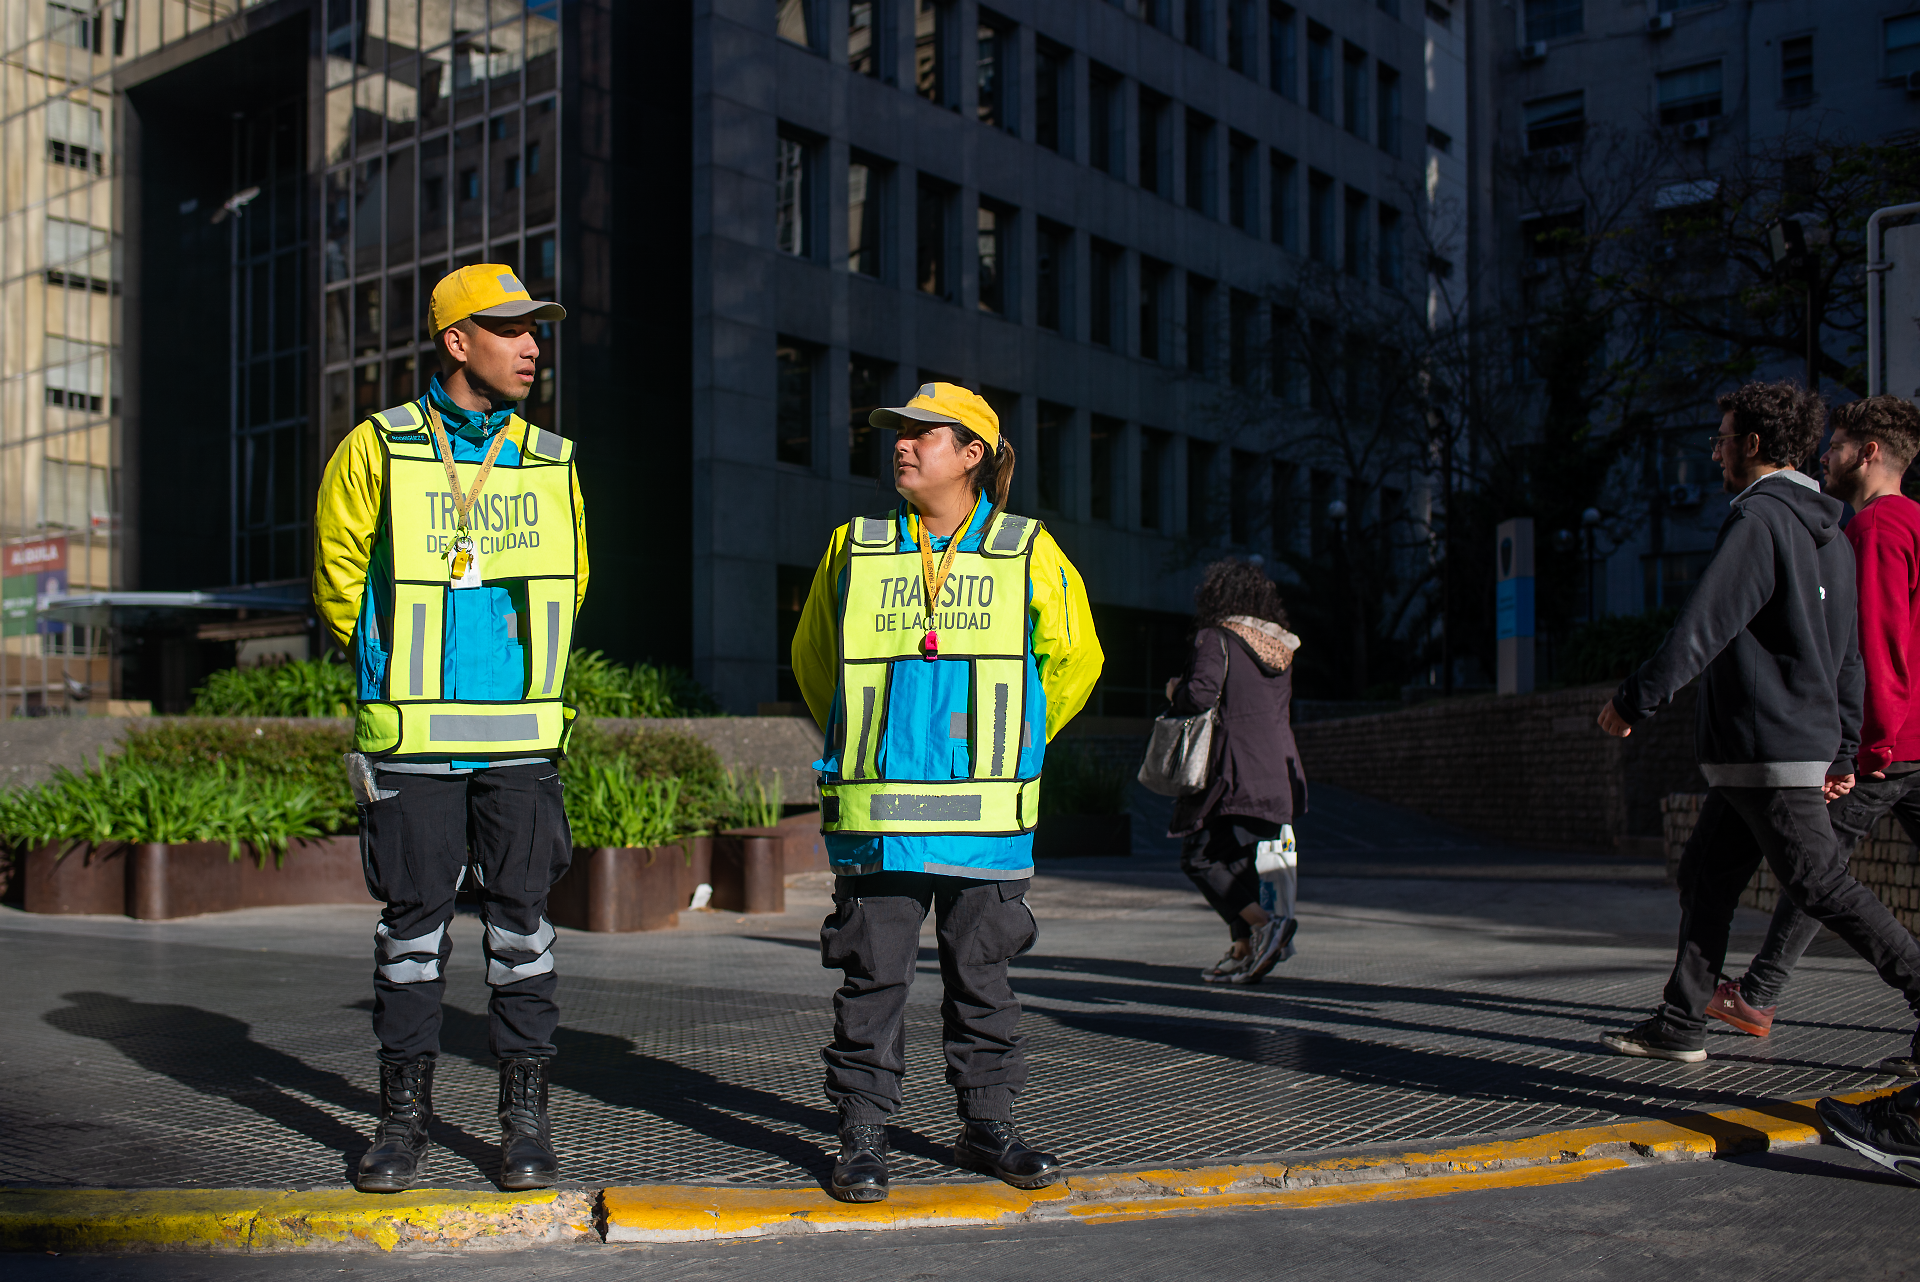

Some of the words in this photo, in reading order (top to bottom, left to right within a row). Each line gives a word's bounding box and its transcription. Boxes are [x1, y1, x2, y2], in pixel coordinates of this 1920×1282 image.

[426, 534, 449, 553] DE
[480, 530, 540, 554] CIUDAD
[875, 613, 897, 632] DE
[902, 612, 922, 630] LA
